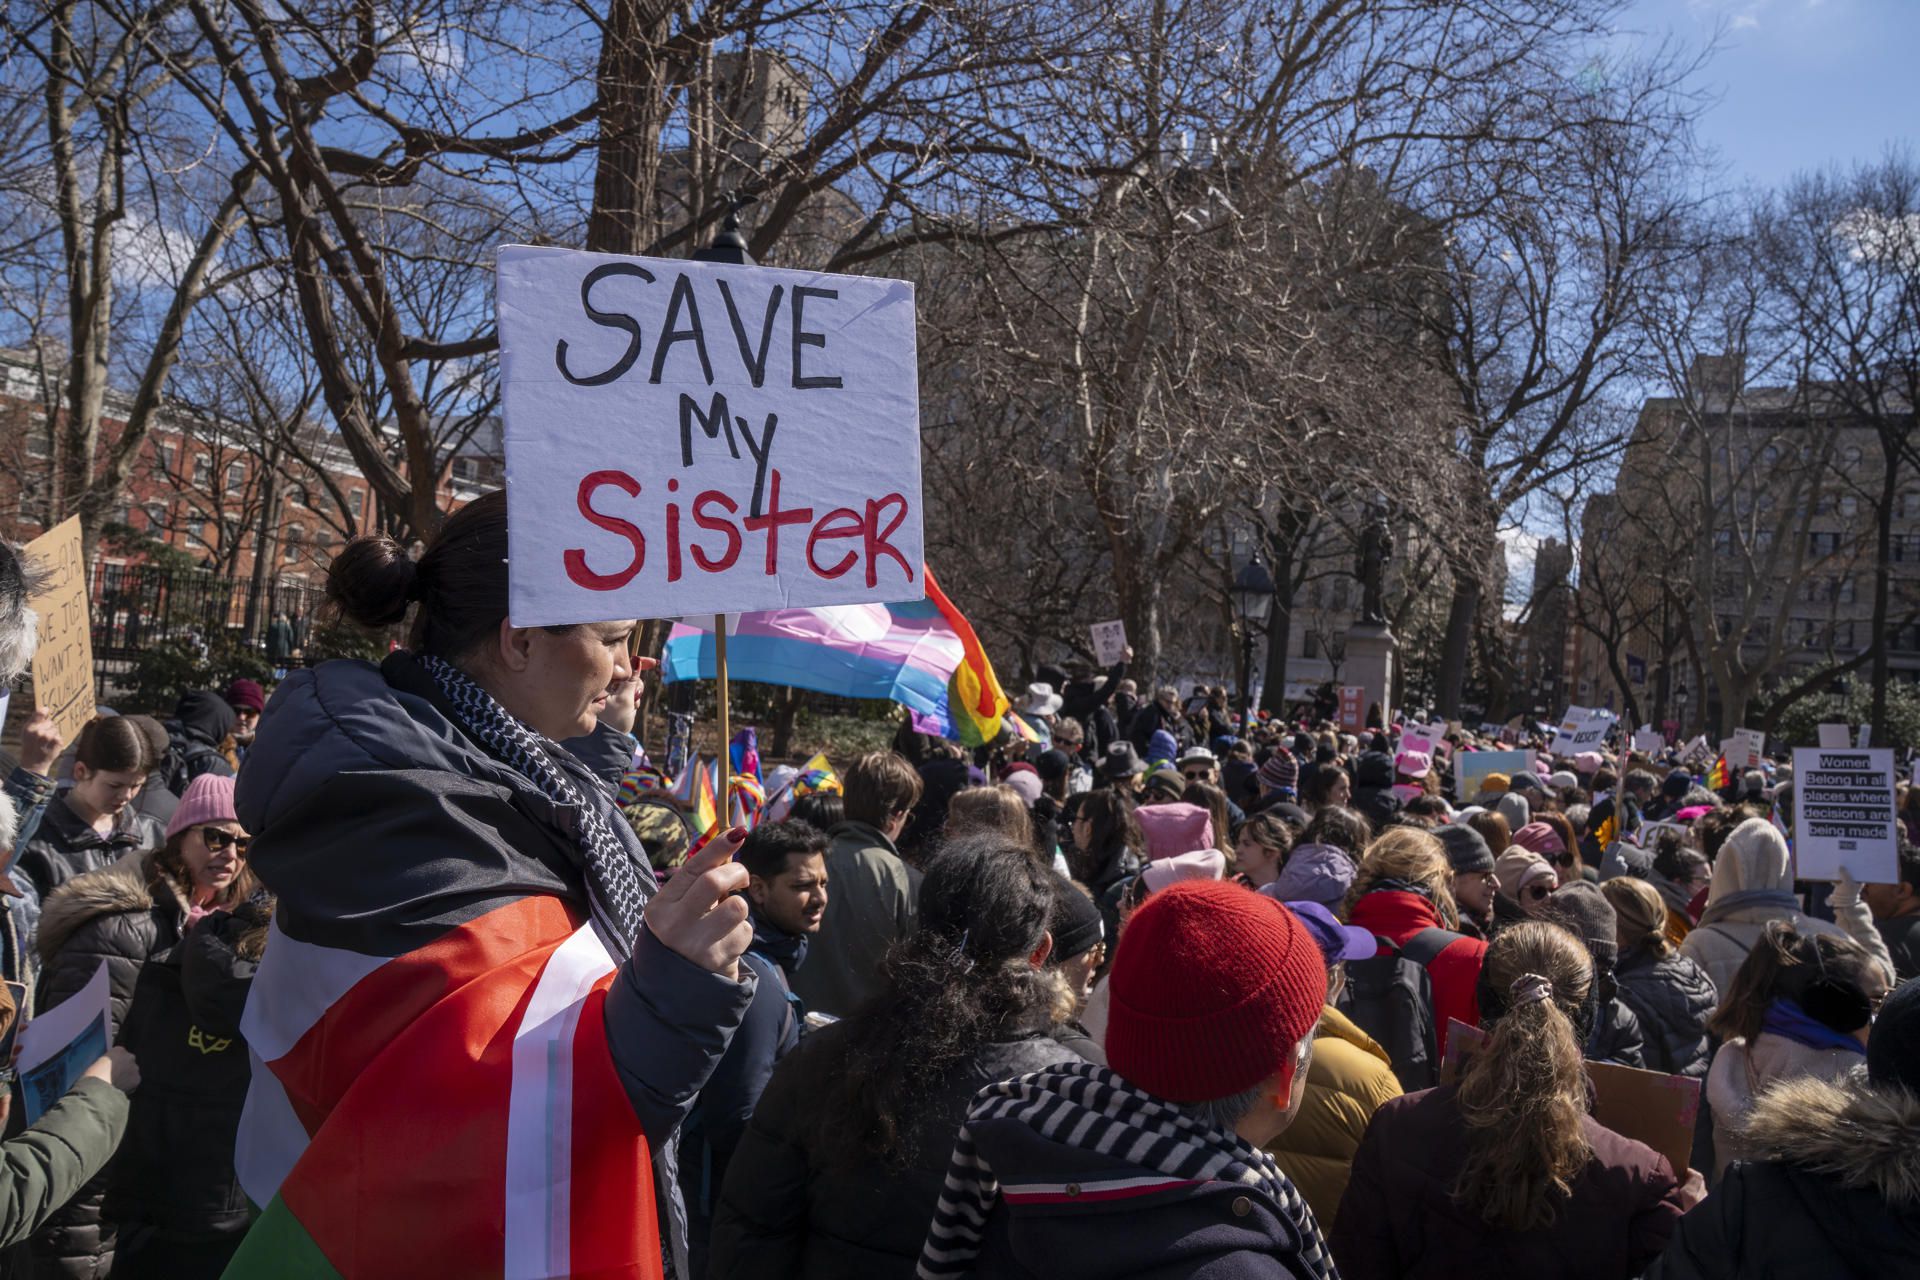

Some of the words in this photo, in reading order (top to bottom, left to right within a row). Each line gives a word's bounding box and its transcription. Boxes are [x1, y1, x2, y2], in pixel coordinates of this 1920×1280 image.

[555, 262, 844, 389] SAVE
[36, 612, 57, 649] WE
[61, 590, 84, 634] JUST
[38, 643, 73, 686] WANT
[1820, 756, 1870, 768] Women
[1806, 773, 1852, 786] Belong
[1856, 774, 1867, 785] in
[1871, 775, 1887, 786] all
[1803, 790, 1846, 802] places
[1849, 791, 1891, 803] where
[1803, 807, 1866, 819] decisions
[1869, 811, 1891, 820] are
[1809, 824, 1845, 837] being
[1849, 826, 1887, 838] made
